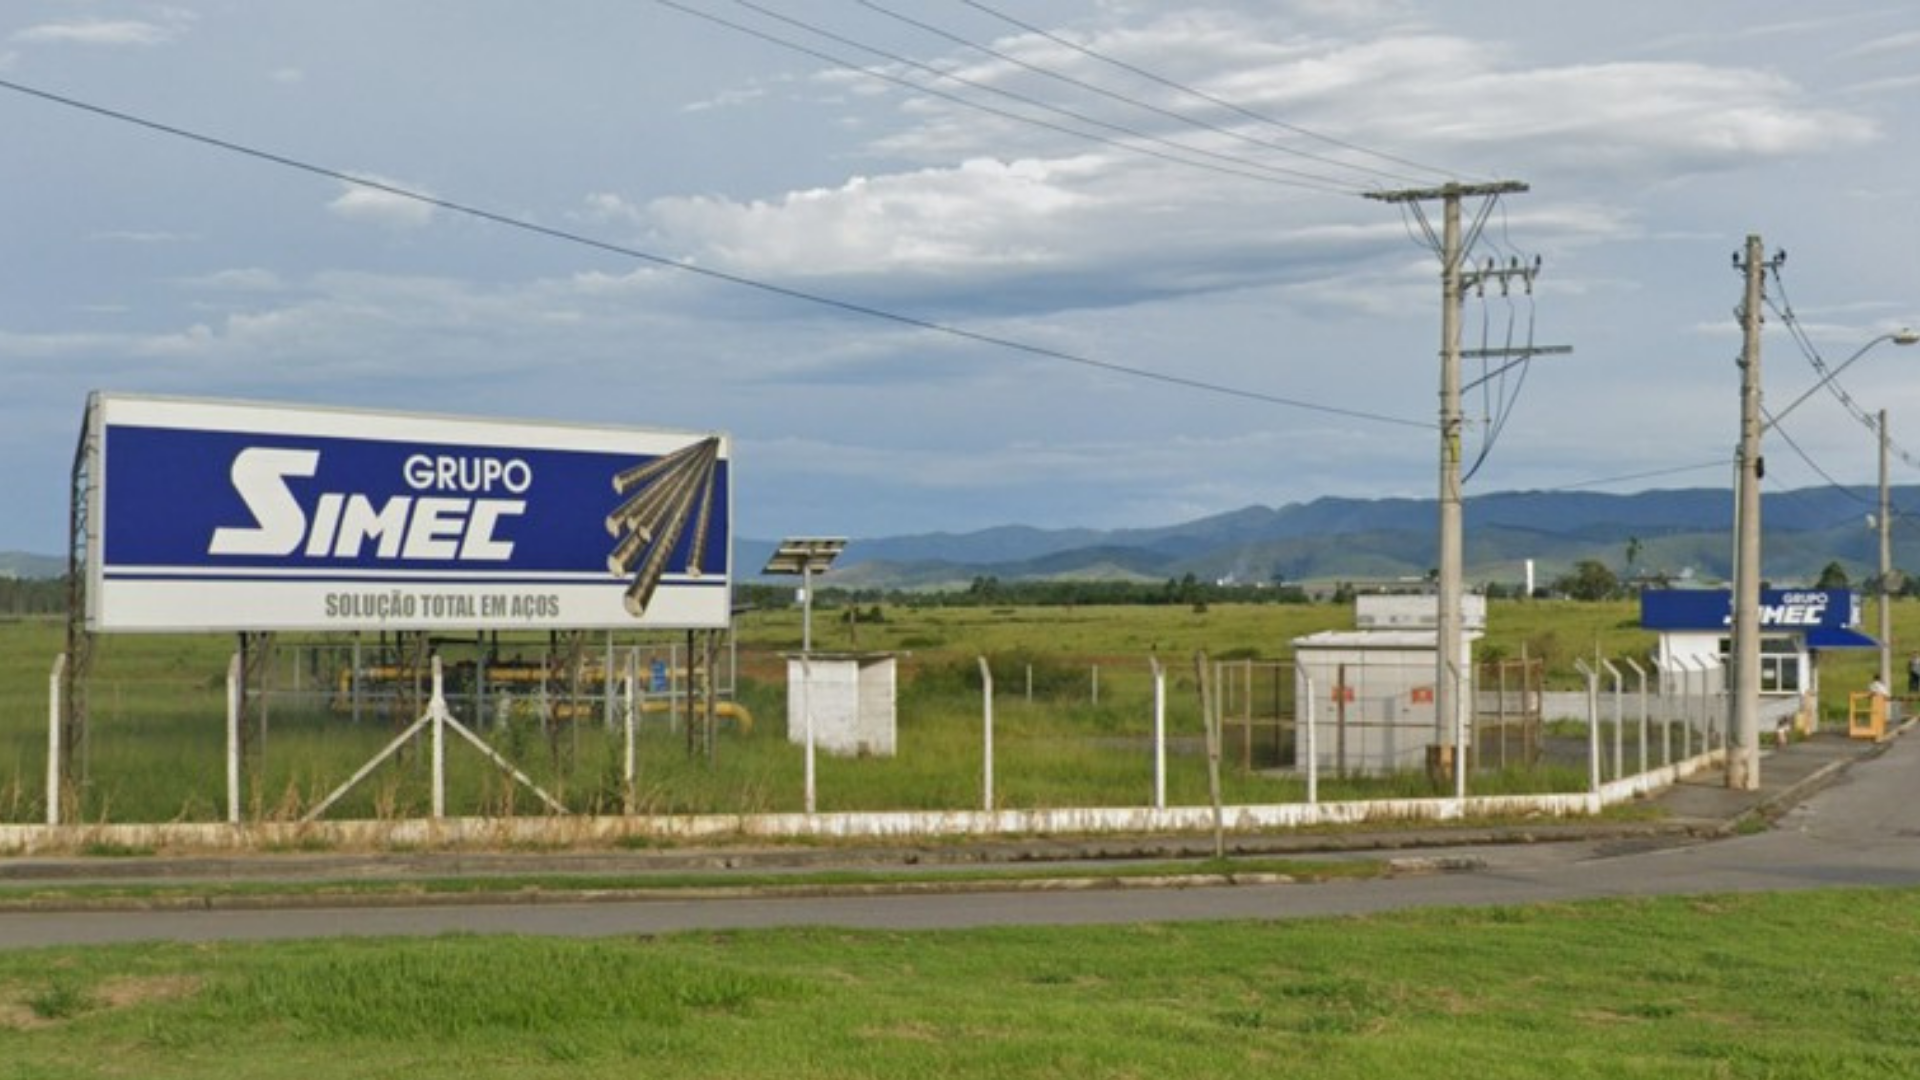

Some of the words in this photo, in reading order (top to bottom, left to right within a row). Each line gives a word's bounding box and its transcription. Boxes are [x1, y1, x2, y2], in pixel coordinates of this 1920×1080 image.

[403, 454, 532, 493] GRUPO
[207, 446, 527, 560] SIMEC
[326, 590, 416, 620] SOLUÇÃO
[421, 594, 476, 618] TOTAL
[481, 595, 507, 618] EM
[511, 595, 560, 621] AÇOS
[1782, 592, 1828, 604] GRUPO
